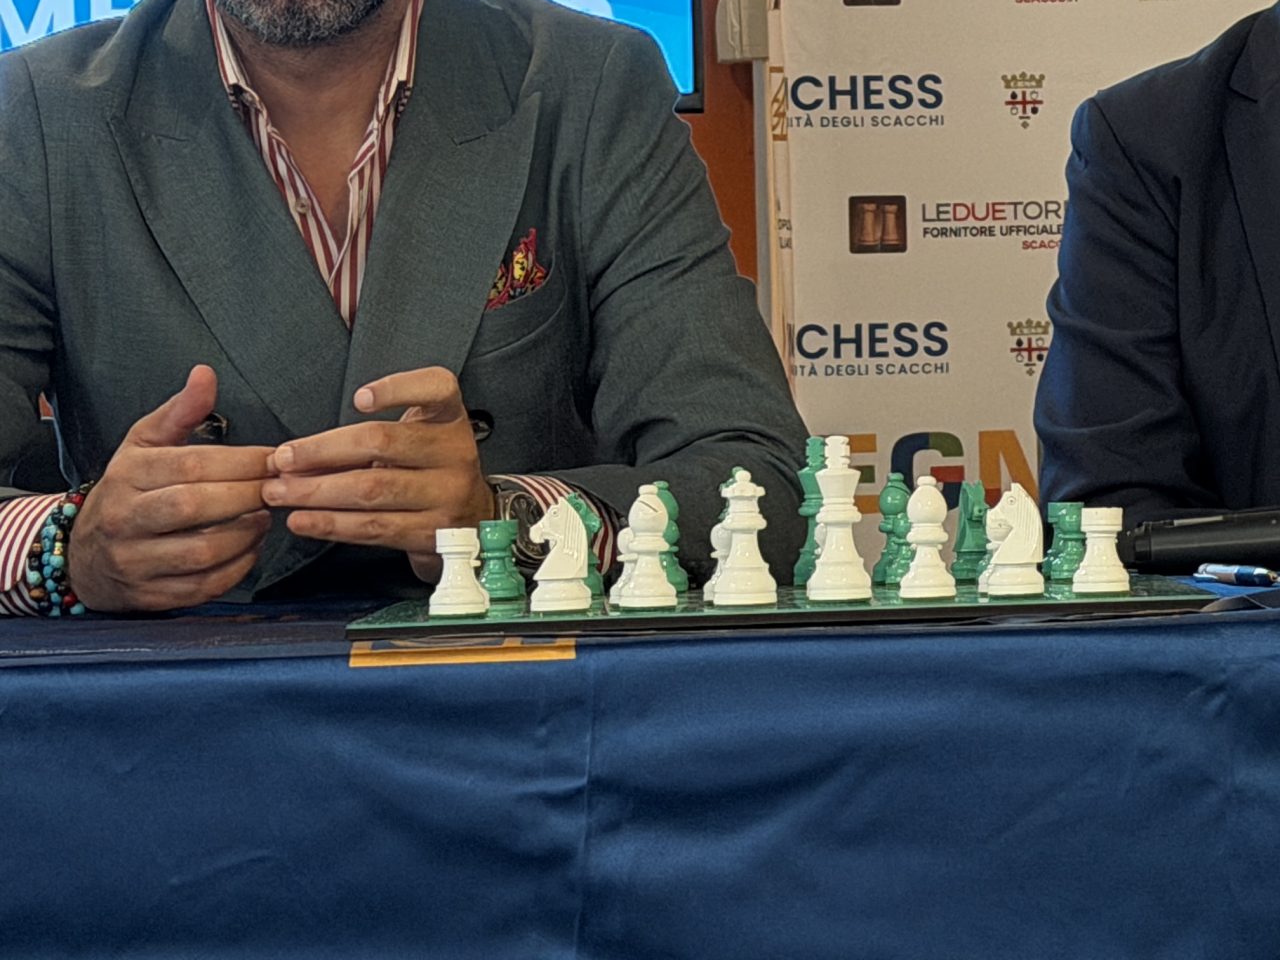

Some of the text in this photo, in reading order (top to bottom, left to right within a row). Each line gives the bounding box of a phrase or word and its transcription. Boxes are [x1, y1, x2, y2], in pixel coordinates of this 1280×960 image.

[820, 116, 864, 127] DEGLI
[871, 115, 944, 127] SCACCHI
[923, 226, 996, 238] FORNITORE
[824, 364, 868, 376] DEGLI
[876, 362, 949, 375] SCACCHI
